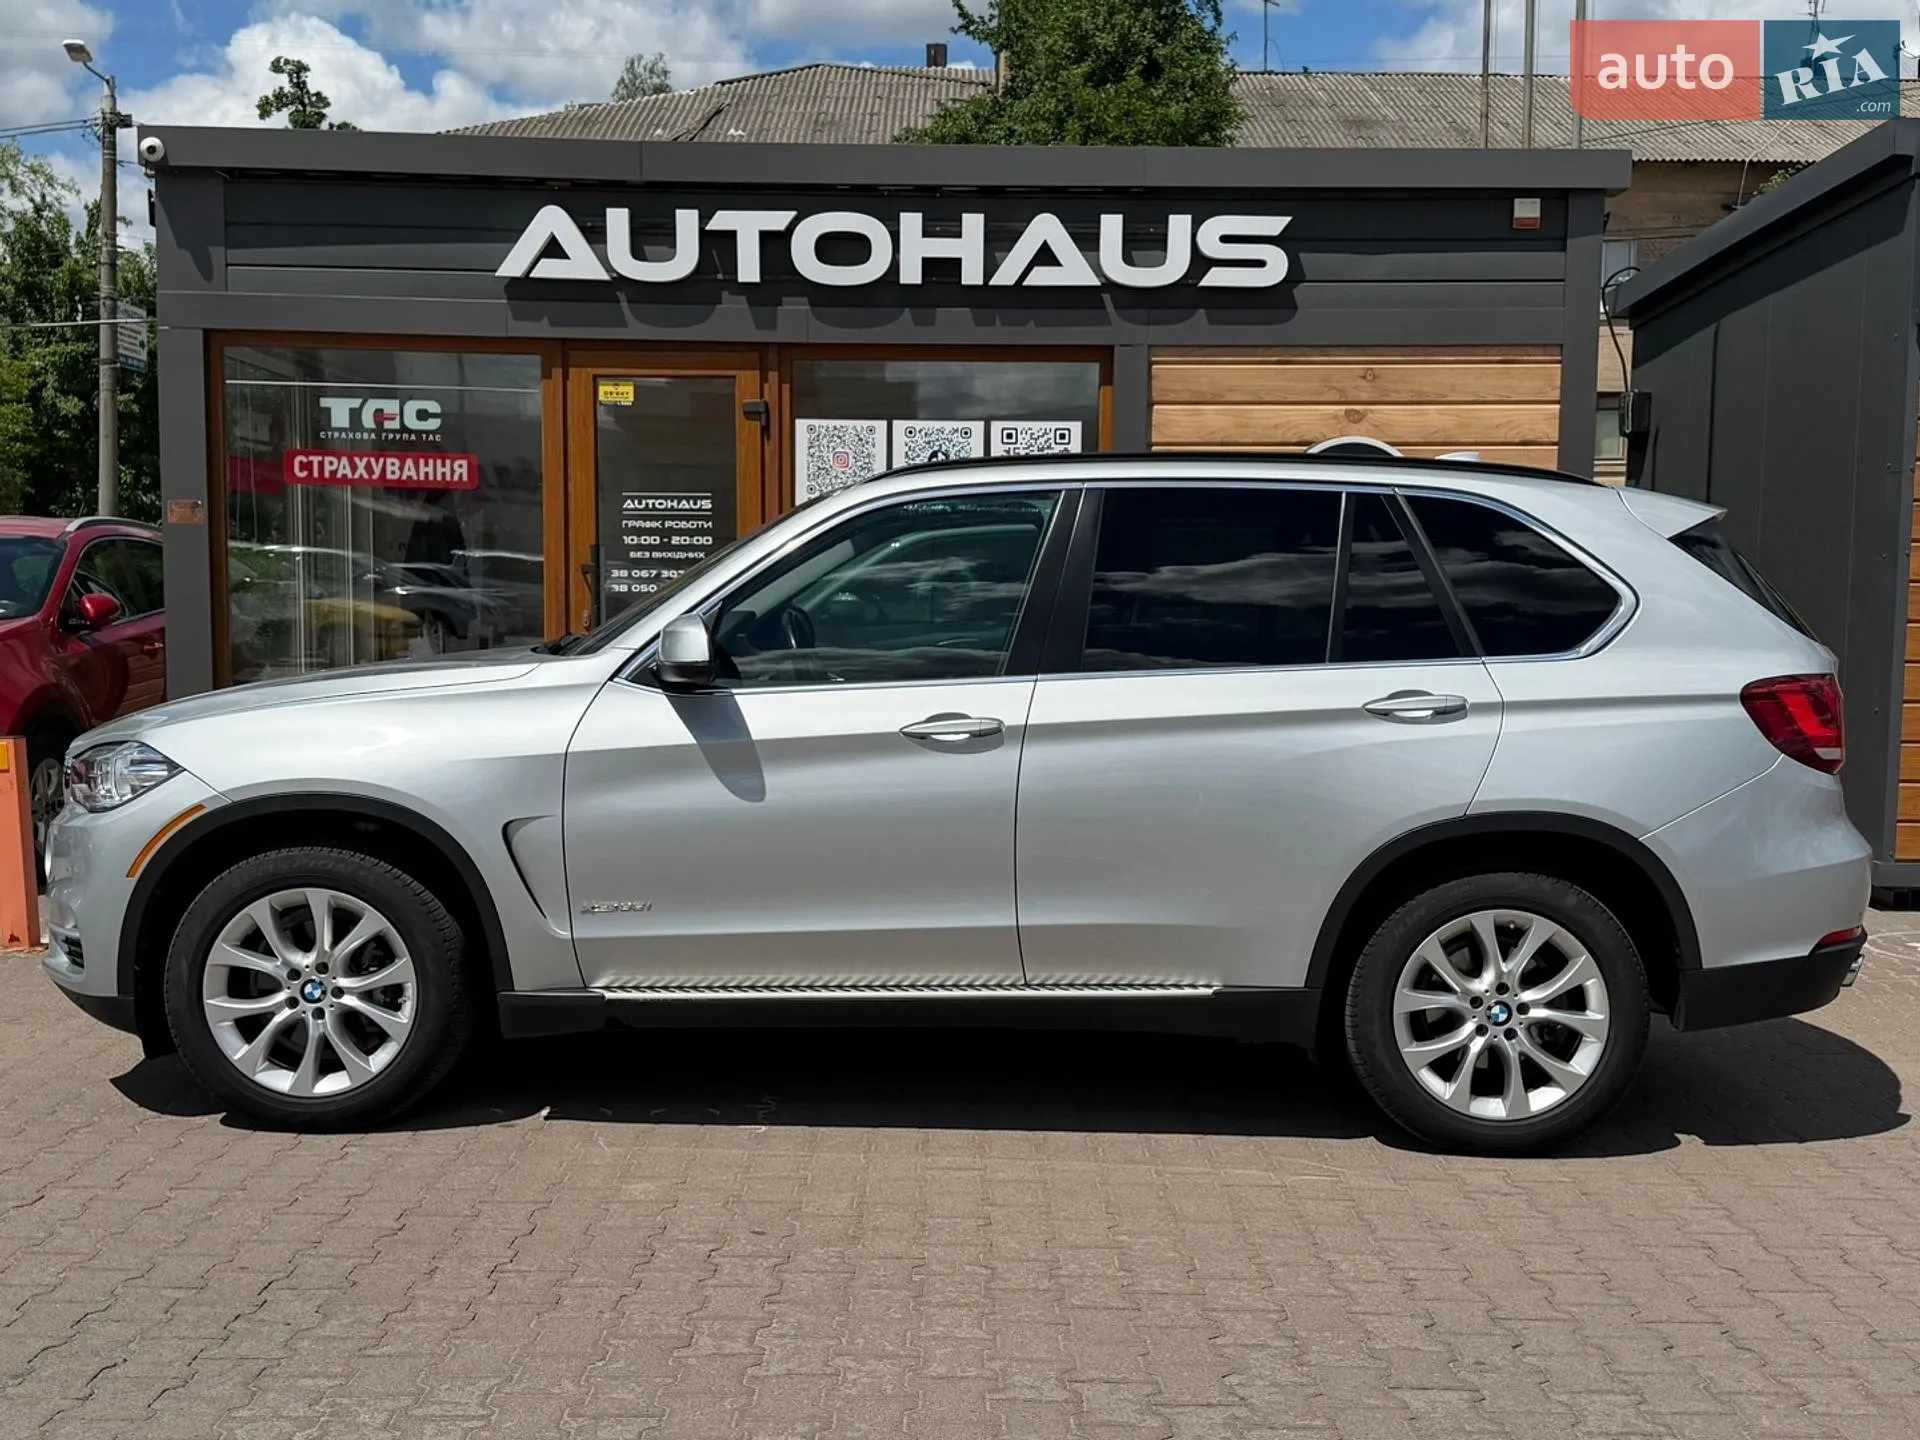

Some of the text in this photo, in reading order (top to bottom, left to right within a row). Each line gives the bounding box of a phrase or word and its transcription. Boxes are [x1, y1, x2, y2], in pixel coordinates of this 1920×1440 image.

[494, 204, 1293, 288] AUTOHAUS
[319, 431, 442, 443] СТРАХОВА ГРУПА ТАС
[293, 455, 468, 482] СТРАХУВАННЯ
[622, 499, 712, 510] AUTOHAUS
[665, 520, 713, 529] РОБОТИ
[623, 535, 660, 545] 10:00
[671, 536, 713, 545] 20:00
[631, 569, 657, 578] 067
